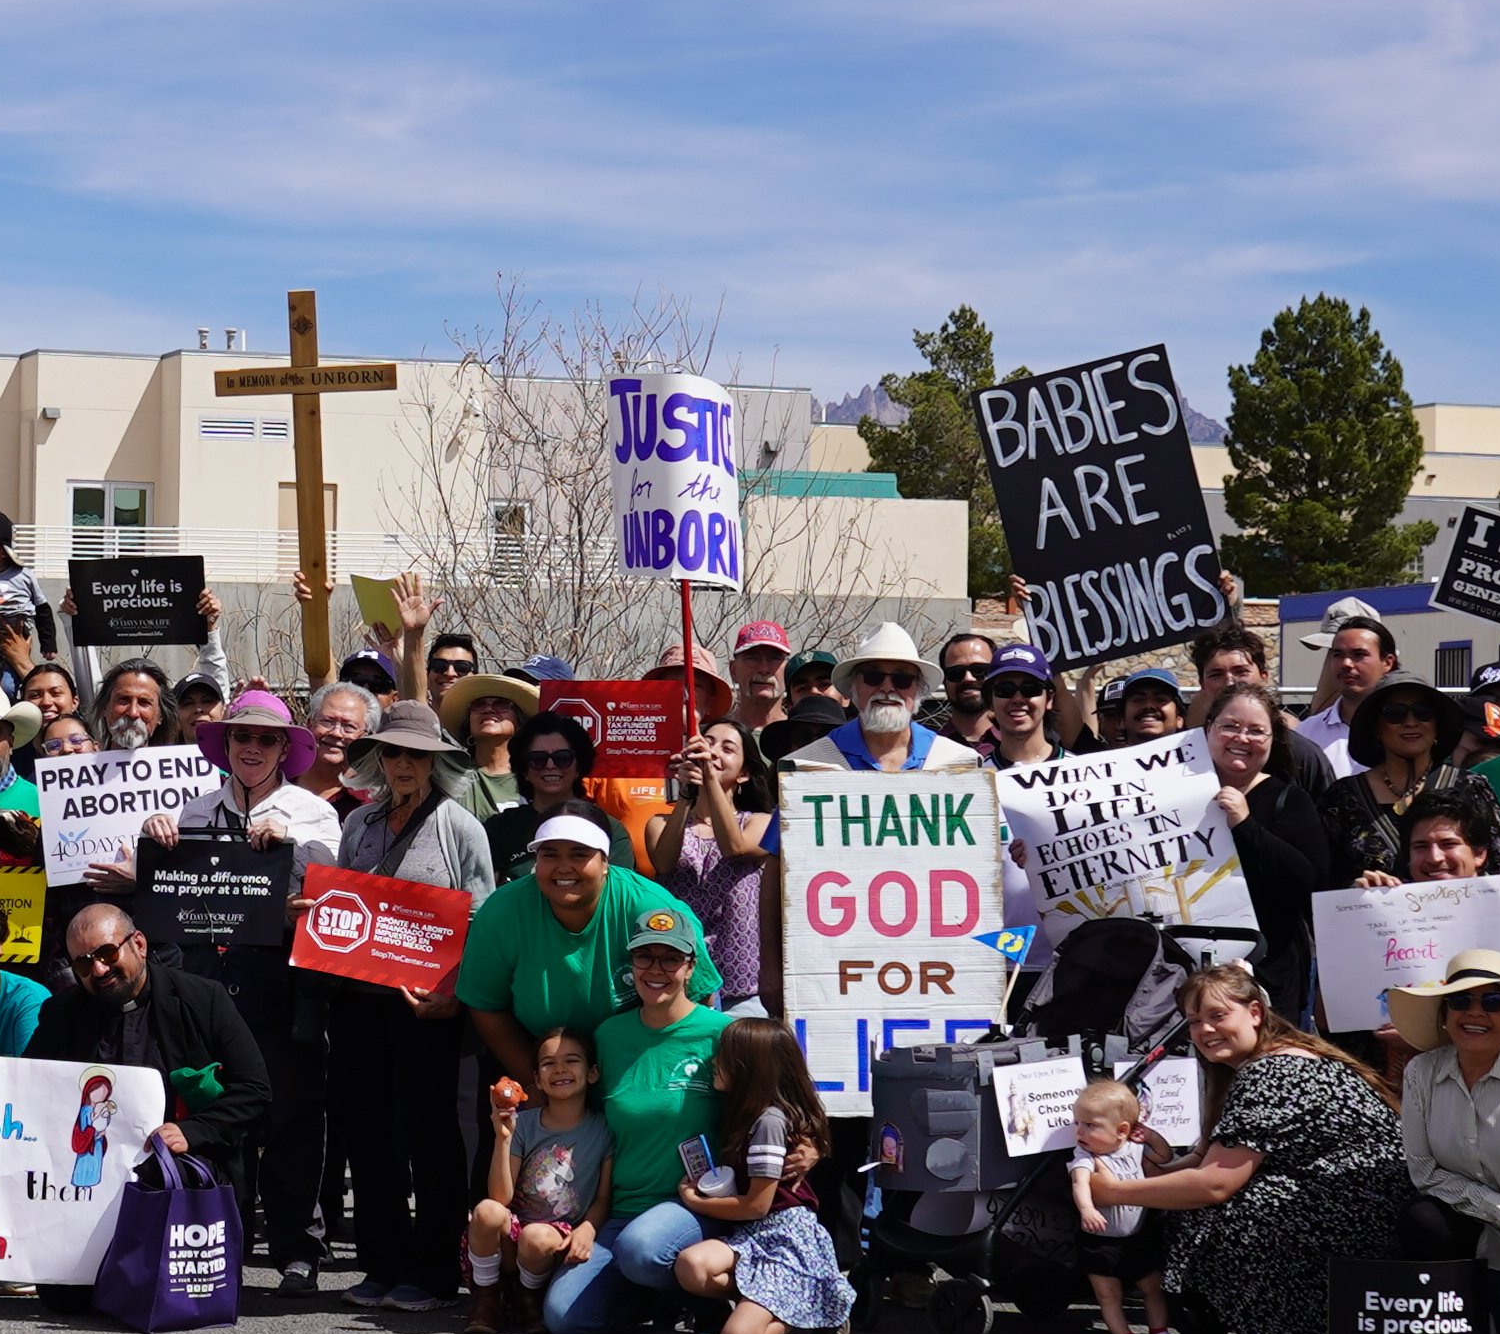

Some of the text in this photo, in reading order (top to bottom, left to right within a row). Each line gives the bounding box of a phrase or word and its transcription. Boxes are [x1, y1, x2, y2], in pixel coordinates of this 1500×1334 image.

[979, 352, 1178, 468] BABIES
[610, 378, 735, 478] JUSTICE
[629, 468, 721, 511] for the
[1036, 453, 1160, 550] ARE
[623, 509, 739, 582] UNBORN
[1467, 514, 1495, 549] I
[92, 579, 182, 597] Every life is
[102, 594, 173, 612] precious.
[1023, 543, 1226, 663] BLESSINGS
[1135, 743, 1195, 771] WE
[41, 756, 213, 792] PRAY TO END
[630, 787, 656, 796] LIFE
[1044, 778, 1148, 808] DO IN
[802, 793, 977, 846] THANK
[1049, 794, 1156, 836] LIFE
[1035, 809, 1182, 866] ECHOES IN
[1038, 827, 1216, 900] ETERNITY
[152, 885, 175, 893] one
[178, 886, 215, 897] prayer
[218, 886, 229, 895] at
[242, 885, 271, 896] time.
[154, 870, 272, 886] Making a difference,
[806, 869, 980, 938] GOD
[318, 906, 363, 930] STOP
[318, 926, 331, 936] THE
[410, 922, 420, 930] AL
[422, 924, 454, 936] ABORTO
[373, 936, 402, 947] NUEVO
[418, 937, 430, 945] EN
[425, 932, 443, 941] CON
[371, 948, 441, 969] StopTheCenter.com
[838, 960, 956, 995] FOR
[1038, 1104, 1075, 1115] Chose
[25, 1170, 93, 1202] them
[170, 1221, 225, 1247] HOPE
[169, 1258, 226, 1275] STARTED
[177, 1250, 199, 1258] JUST
[1365, 1290, 1463, 1319] Every life
[1358, 1311, 1376, 1332] is
